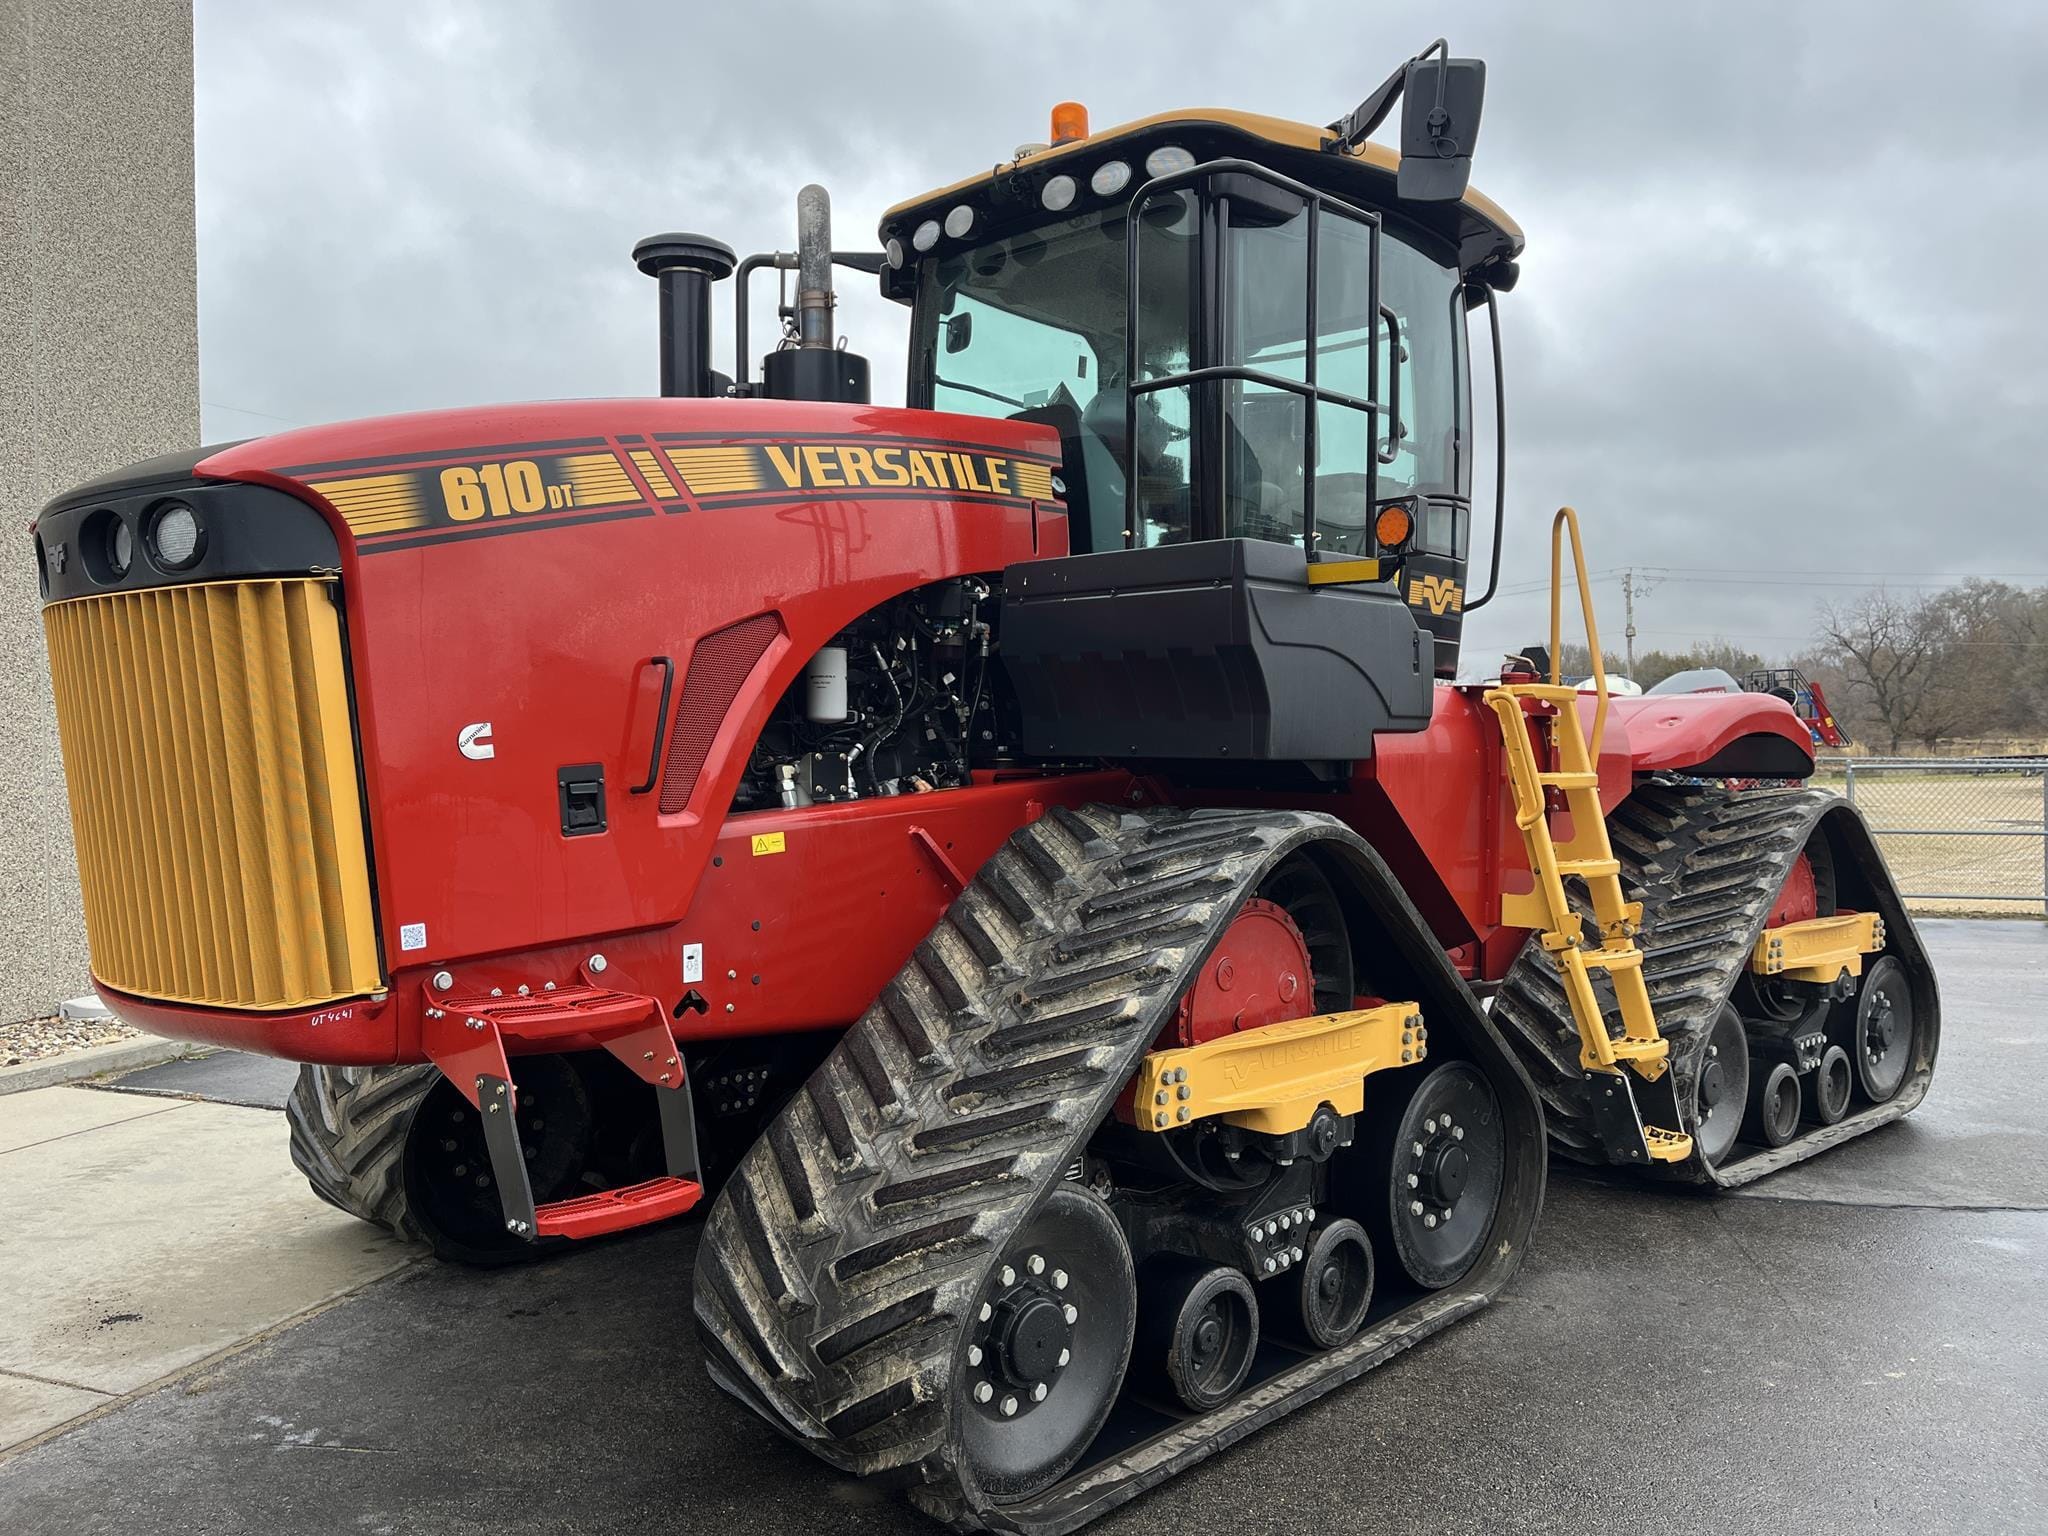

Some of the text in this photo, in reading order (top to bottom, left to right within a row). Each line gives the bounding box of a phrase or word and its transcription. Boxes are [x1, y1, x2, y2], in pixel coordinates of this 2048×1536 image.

[440, 460, 574, 521] 610 DT
[764, 446, 1012, 495] VERSATILE
[460, 723, 488, 748] Cummins
[1257, 1030, 1361, 1070] VERSATILE
